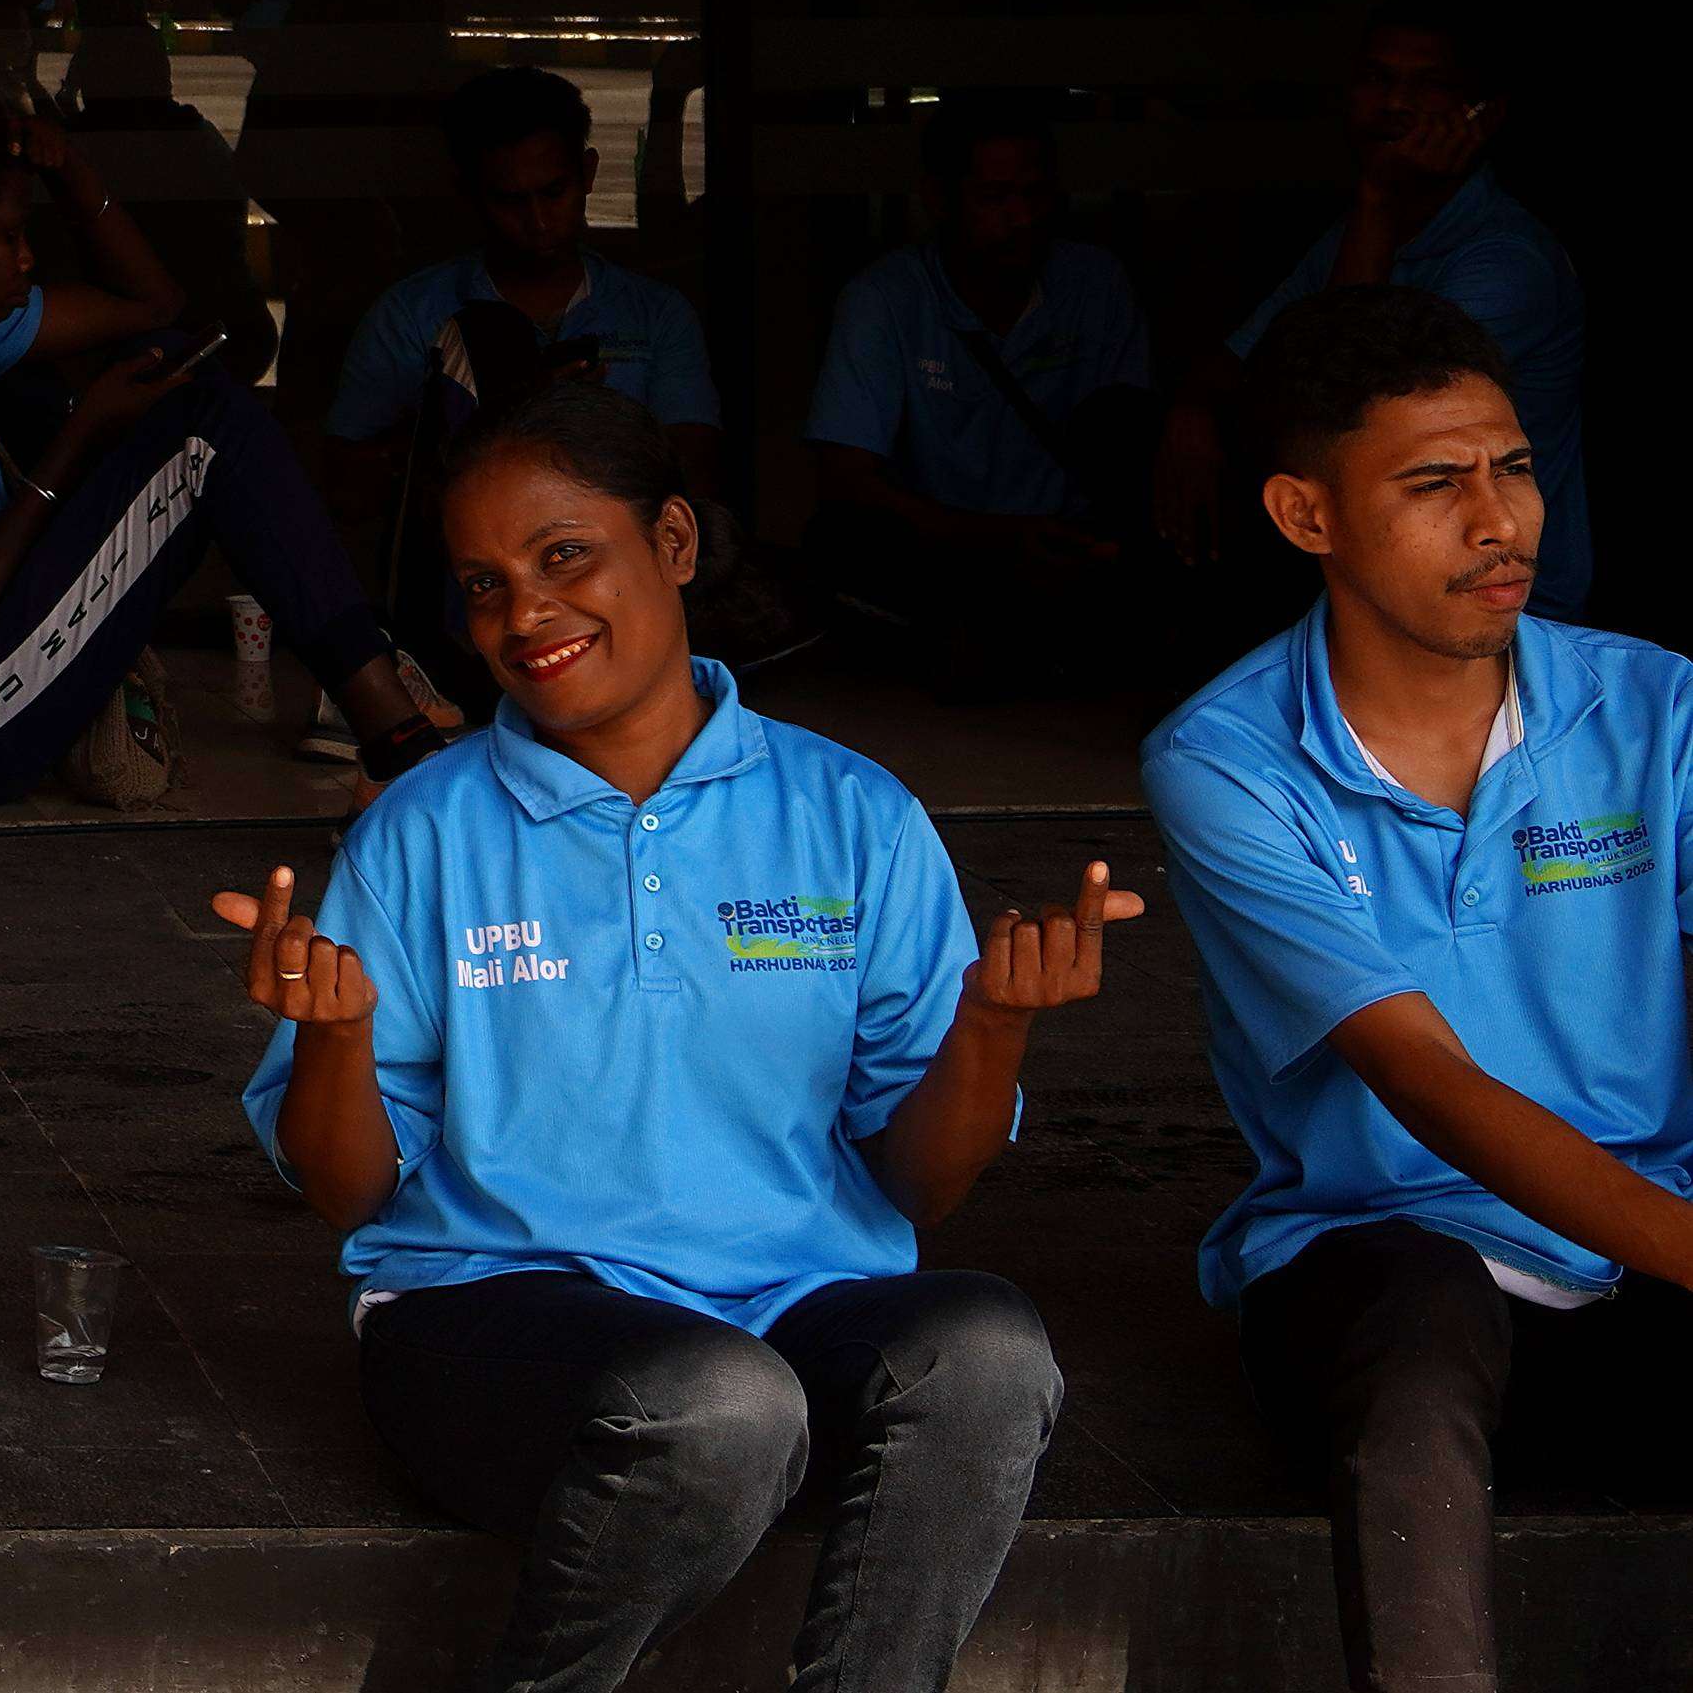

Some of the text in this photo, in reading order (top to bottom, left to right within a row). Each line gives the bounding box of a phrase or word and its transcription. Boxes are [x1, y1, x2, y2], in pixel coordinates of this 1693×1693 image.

[1513, 817, 1649, 863] Transportasi
[1527, 819, 1584, 845] Bakti
[1525, 858, 1656, 897] HARHUBNAS 2025
[735, 895, 800, 920] Bakti
[465, 920, 542, 956] UPBU
[456, 953, 570, 989] Mali Alor
[730, 957, 857, 973] HARHUBNAS 202
